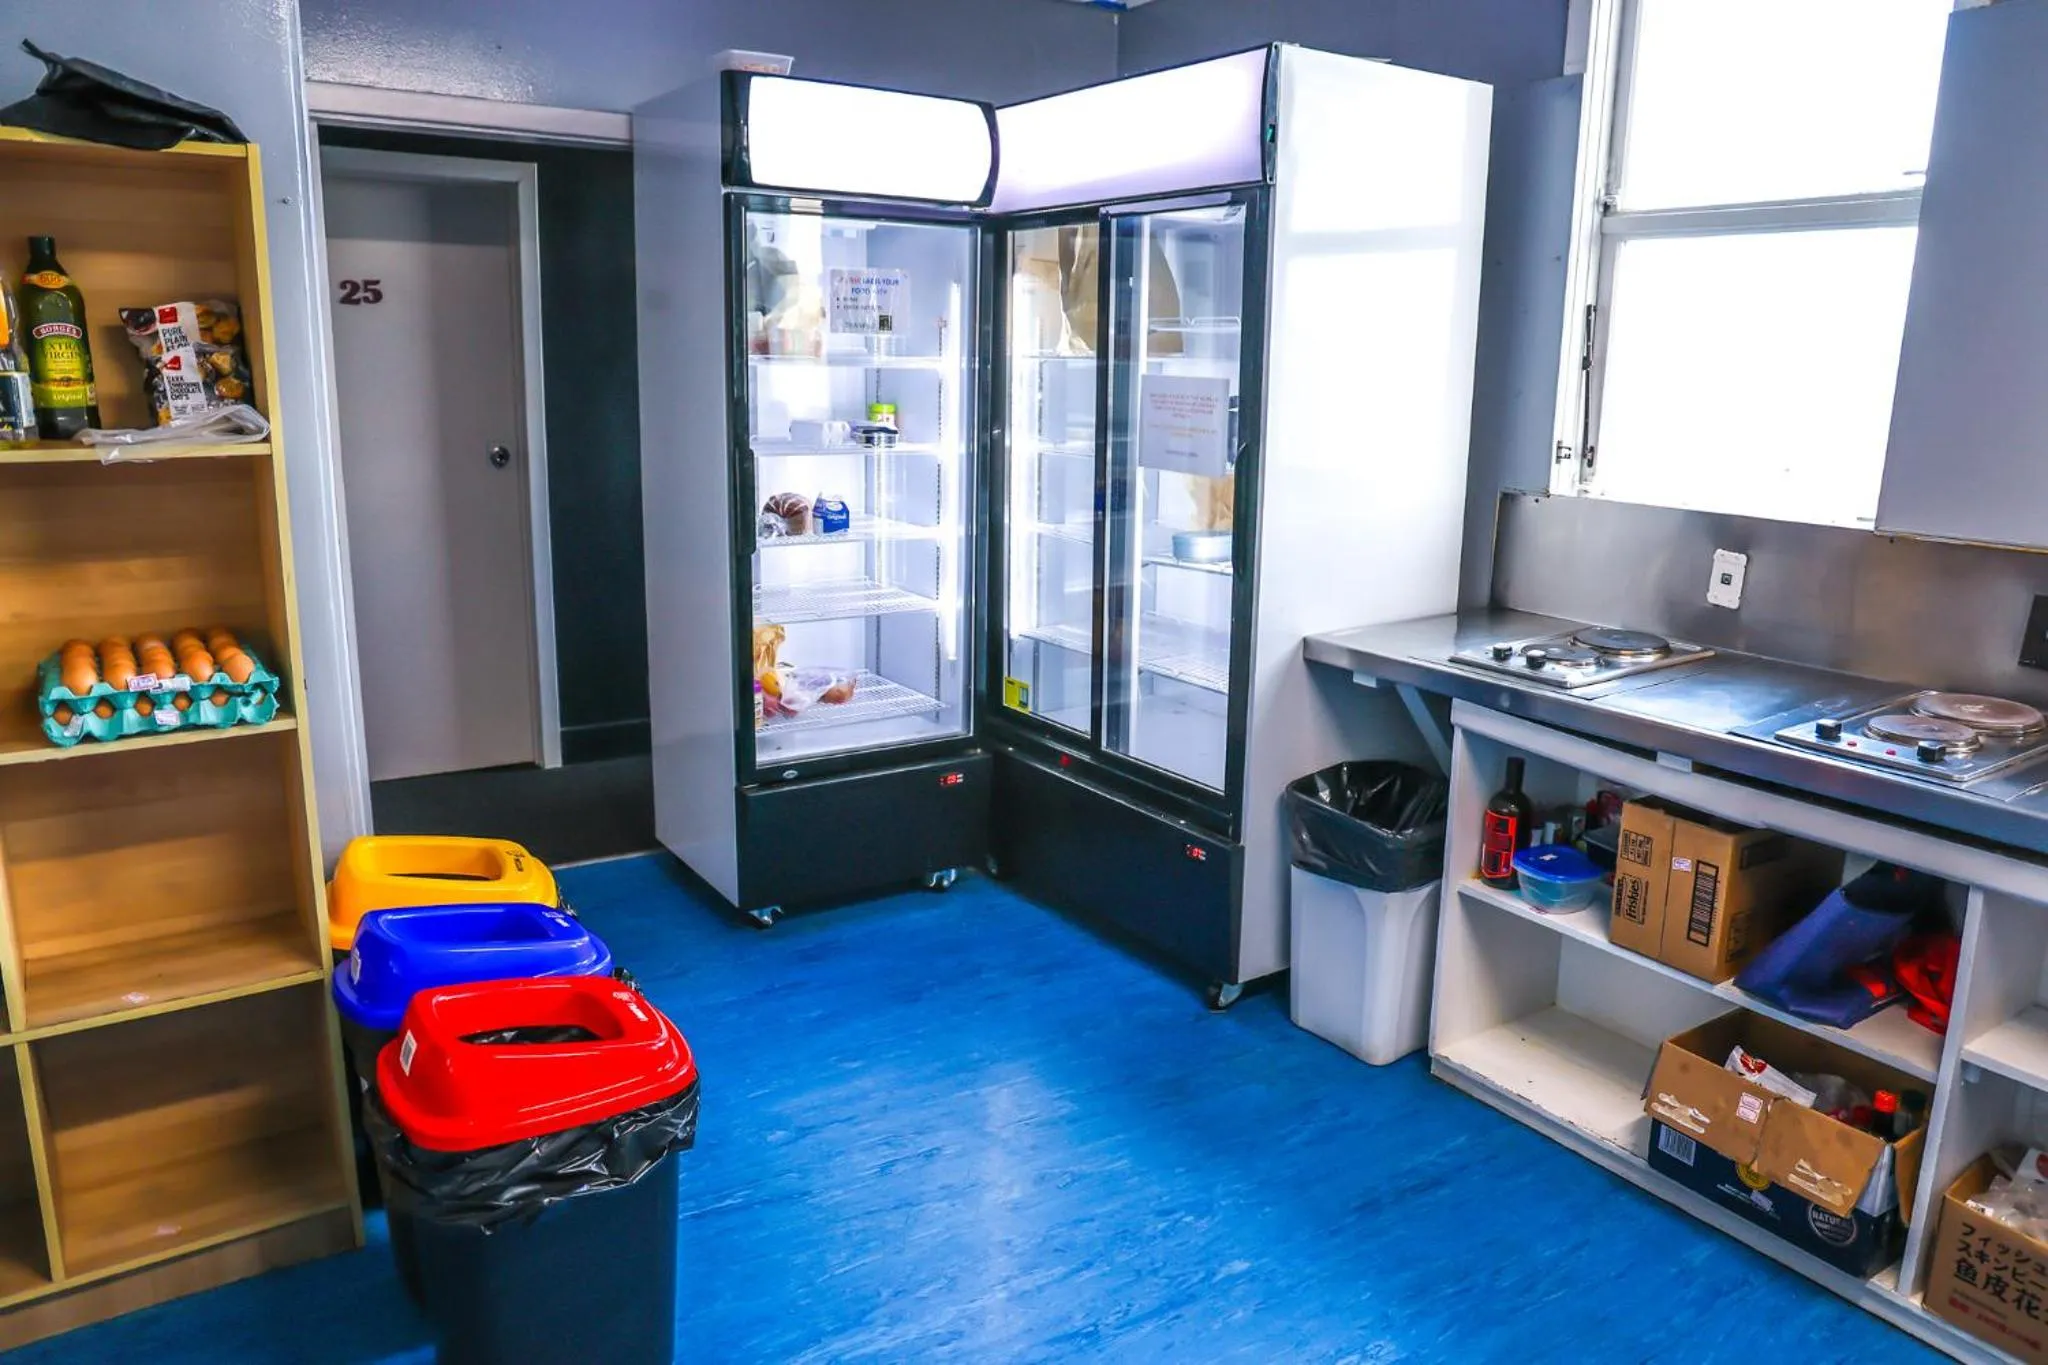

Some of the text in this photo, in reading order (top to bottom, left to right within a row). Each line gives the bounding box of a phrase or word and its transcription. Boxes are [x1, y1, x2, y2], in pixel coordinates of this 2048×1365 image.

[339, 279, 384, 306] 25
[40, 323, 77, 335] BORGES
[1625, 879, 1641, 919] Friskies
[1962, 1222, 2048, 1277] フィッシュ
